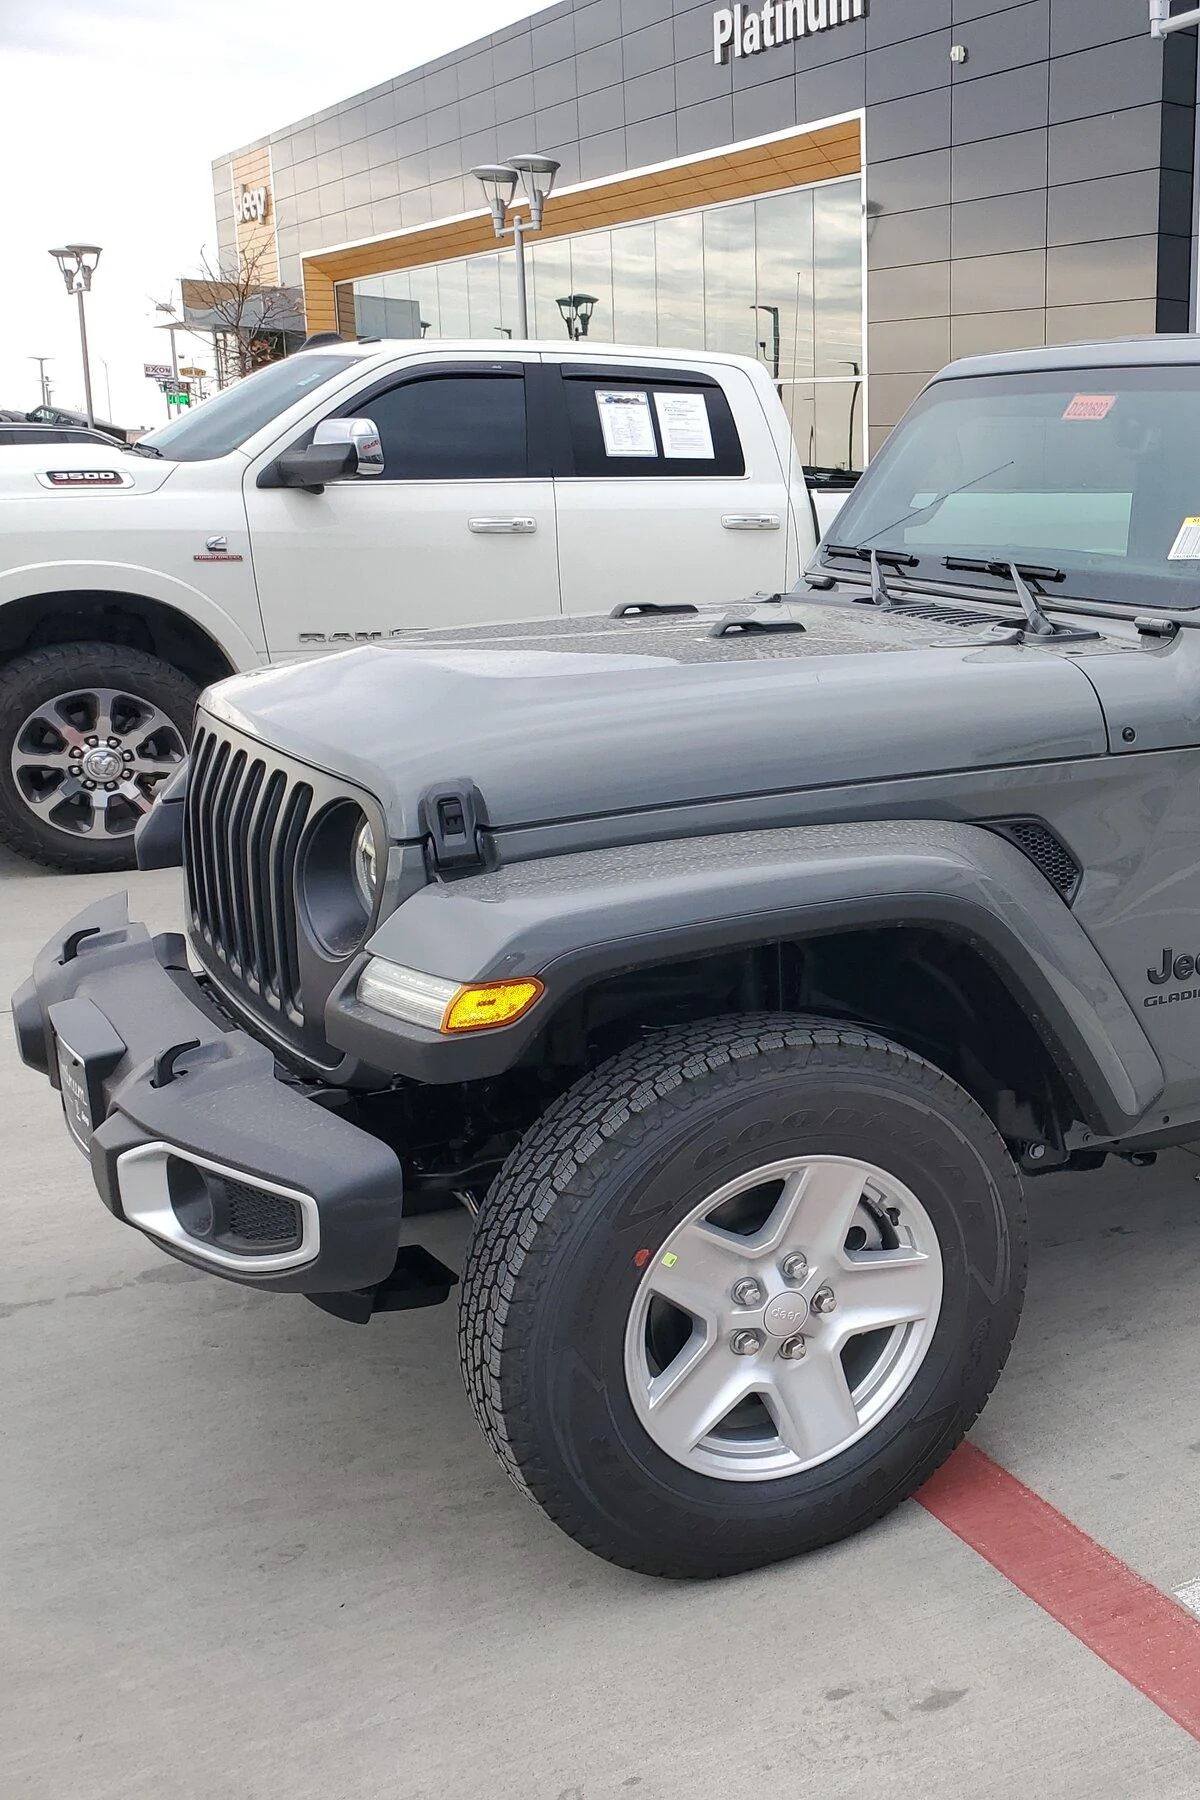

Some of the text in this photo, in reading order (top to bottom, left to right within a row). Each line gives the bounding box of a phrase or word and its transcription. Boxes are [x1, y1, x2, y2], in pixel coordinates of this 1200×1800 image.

[713, 0, 863, 64] Platinum
[234, 184, 268, 225] Jeep
[53, 472, 115, 480] 3500
[299, 632, 382, 642] RAM
[771, 1307, 801, 1323] Jeep
